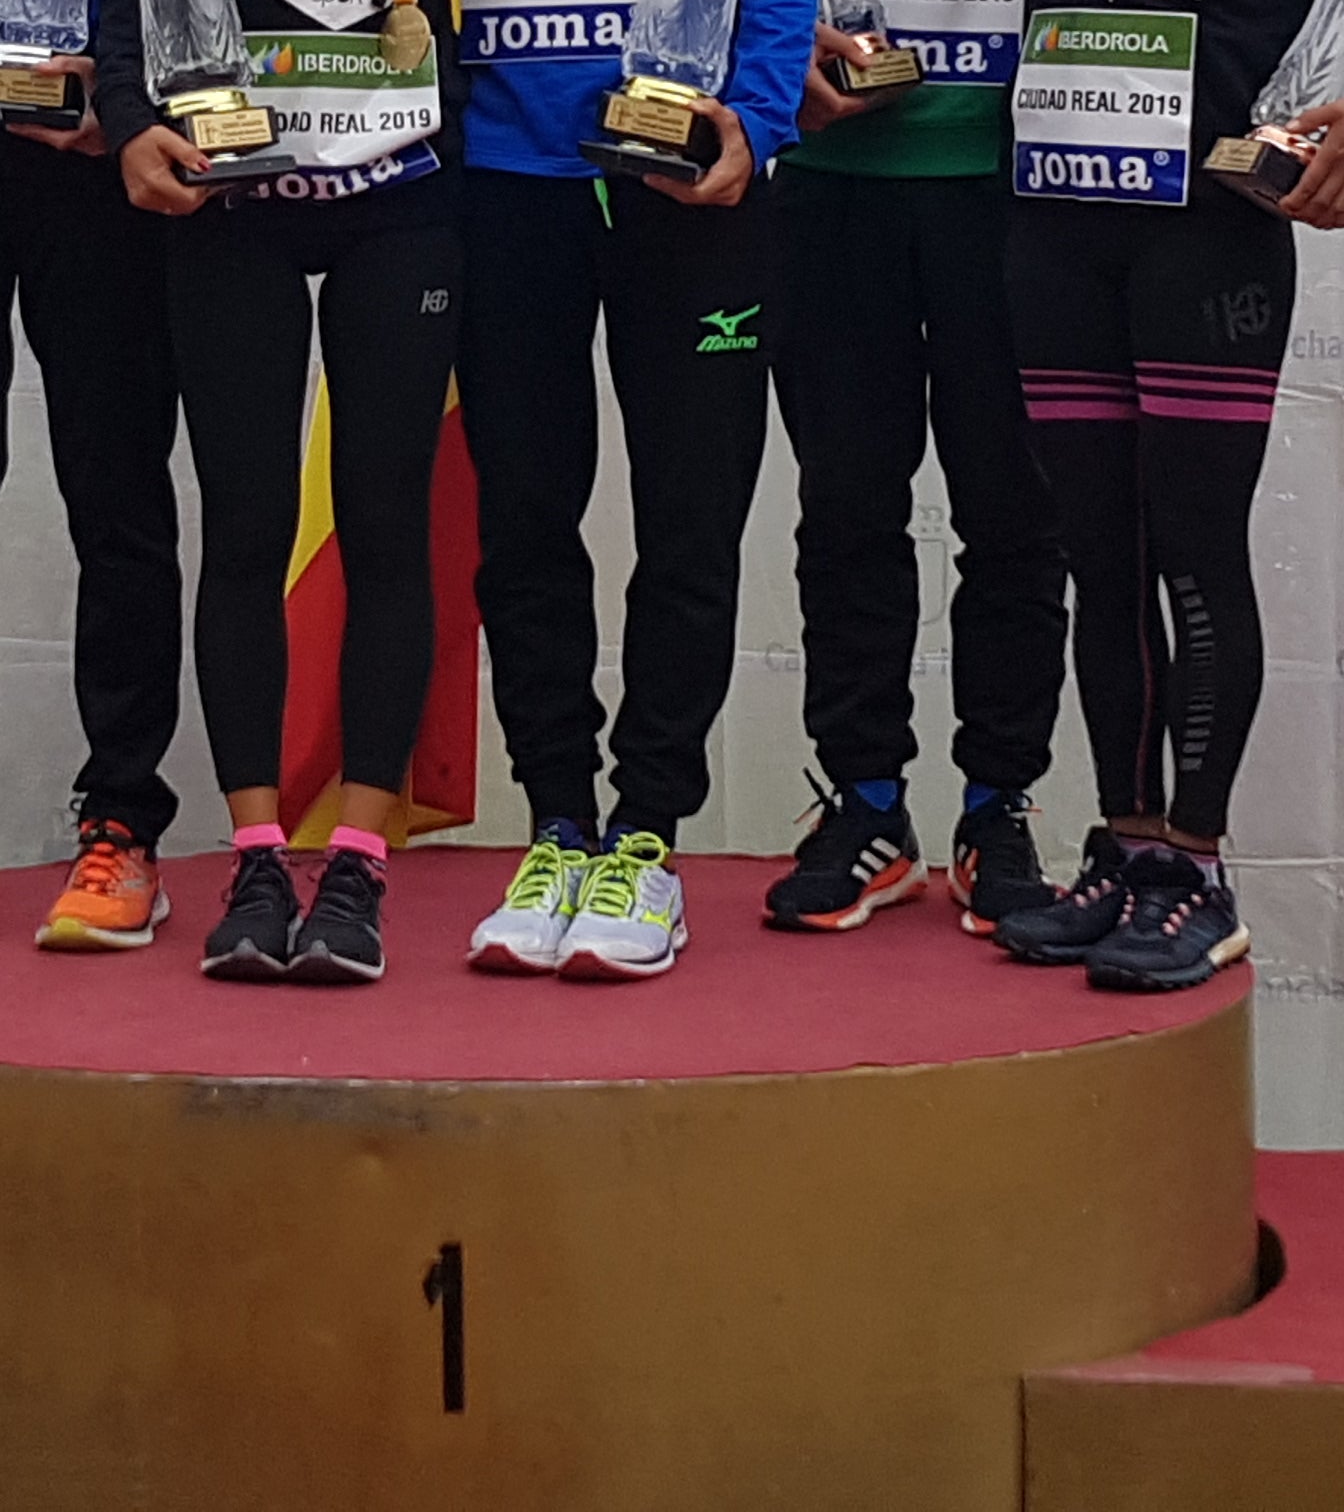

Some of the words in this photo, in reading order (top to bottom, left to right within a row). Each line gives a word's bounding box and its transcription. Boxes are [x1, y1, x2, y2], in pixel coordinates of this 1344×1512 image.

[1057, 30, 1170, 54] IBERDROLA
[297, 53, 414, 76] IBERDRO
[1017, 88, 1067, 111] CIUDAD
[1071, 90, 1122, 114] REAL
[1128, 93, 1182, 117] 2019
[276, 111, 312, 134] DAD
[320, 112, 373, 134] REAL
[379, 108, 431, 132] 2019
[1290, 330, 1344, 361] cha
[422, 1240, 465, 1415] 1
